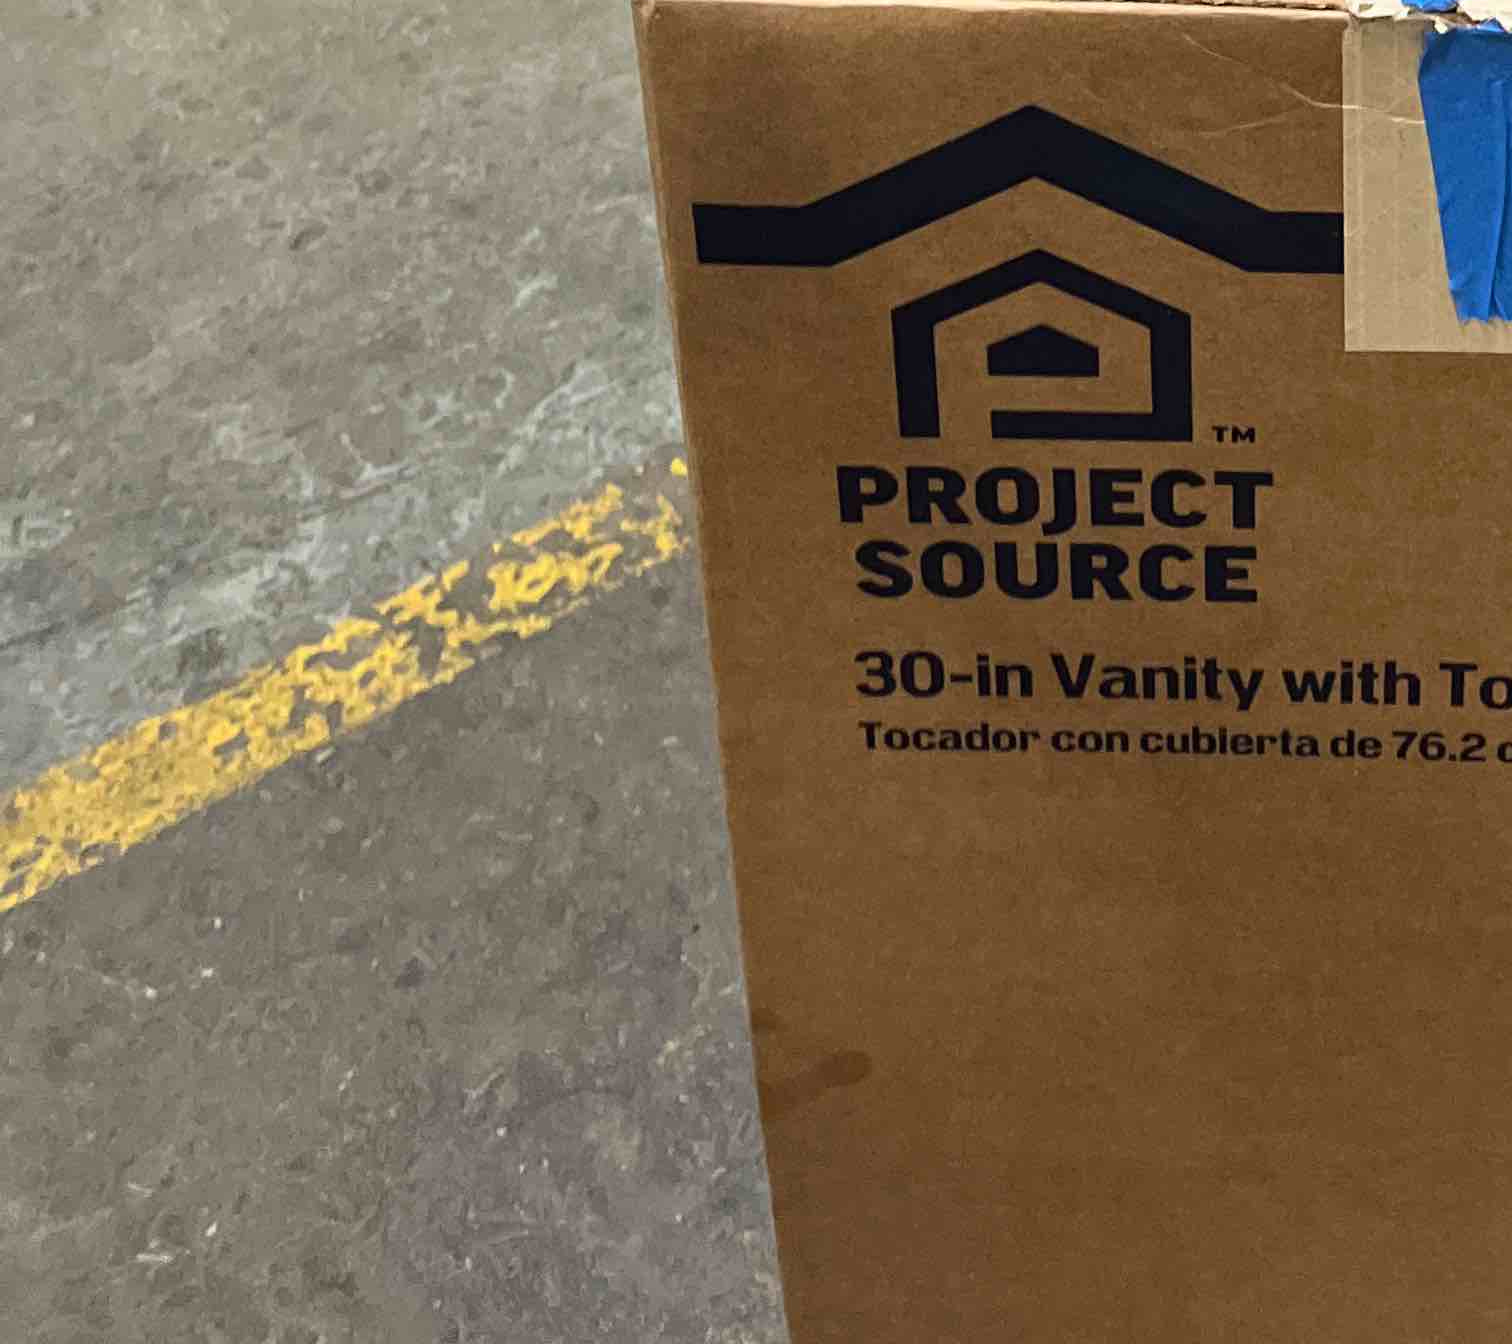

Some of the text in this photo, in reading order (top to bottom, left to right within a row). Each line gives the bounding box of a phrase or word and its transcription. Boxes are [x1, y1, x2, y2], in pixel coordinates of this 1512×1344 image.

[836, 464, 1275, 535] PROJECT
[854, 539, 1260, 603] SOURCE
[854, 649, 1035, 700] 30-in
[1050, 652, 1264, 711] Vanity
[1281, 655, 1422, 707] with
[859, 720, 1041, 754] Tocador
[1050, 728, 1130, 755] con
[1139, 724, 1321, 760] cubierta
[1330, 730, 1383, 760] de
[1390, 731, 1488, 763] 76.2
